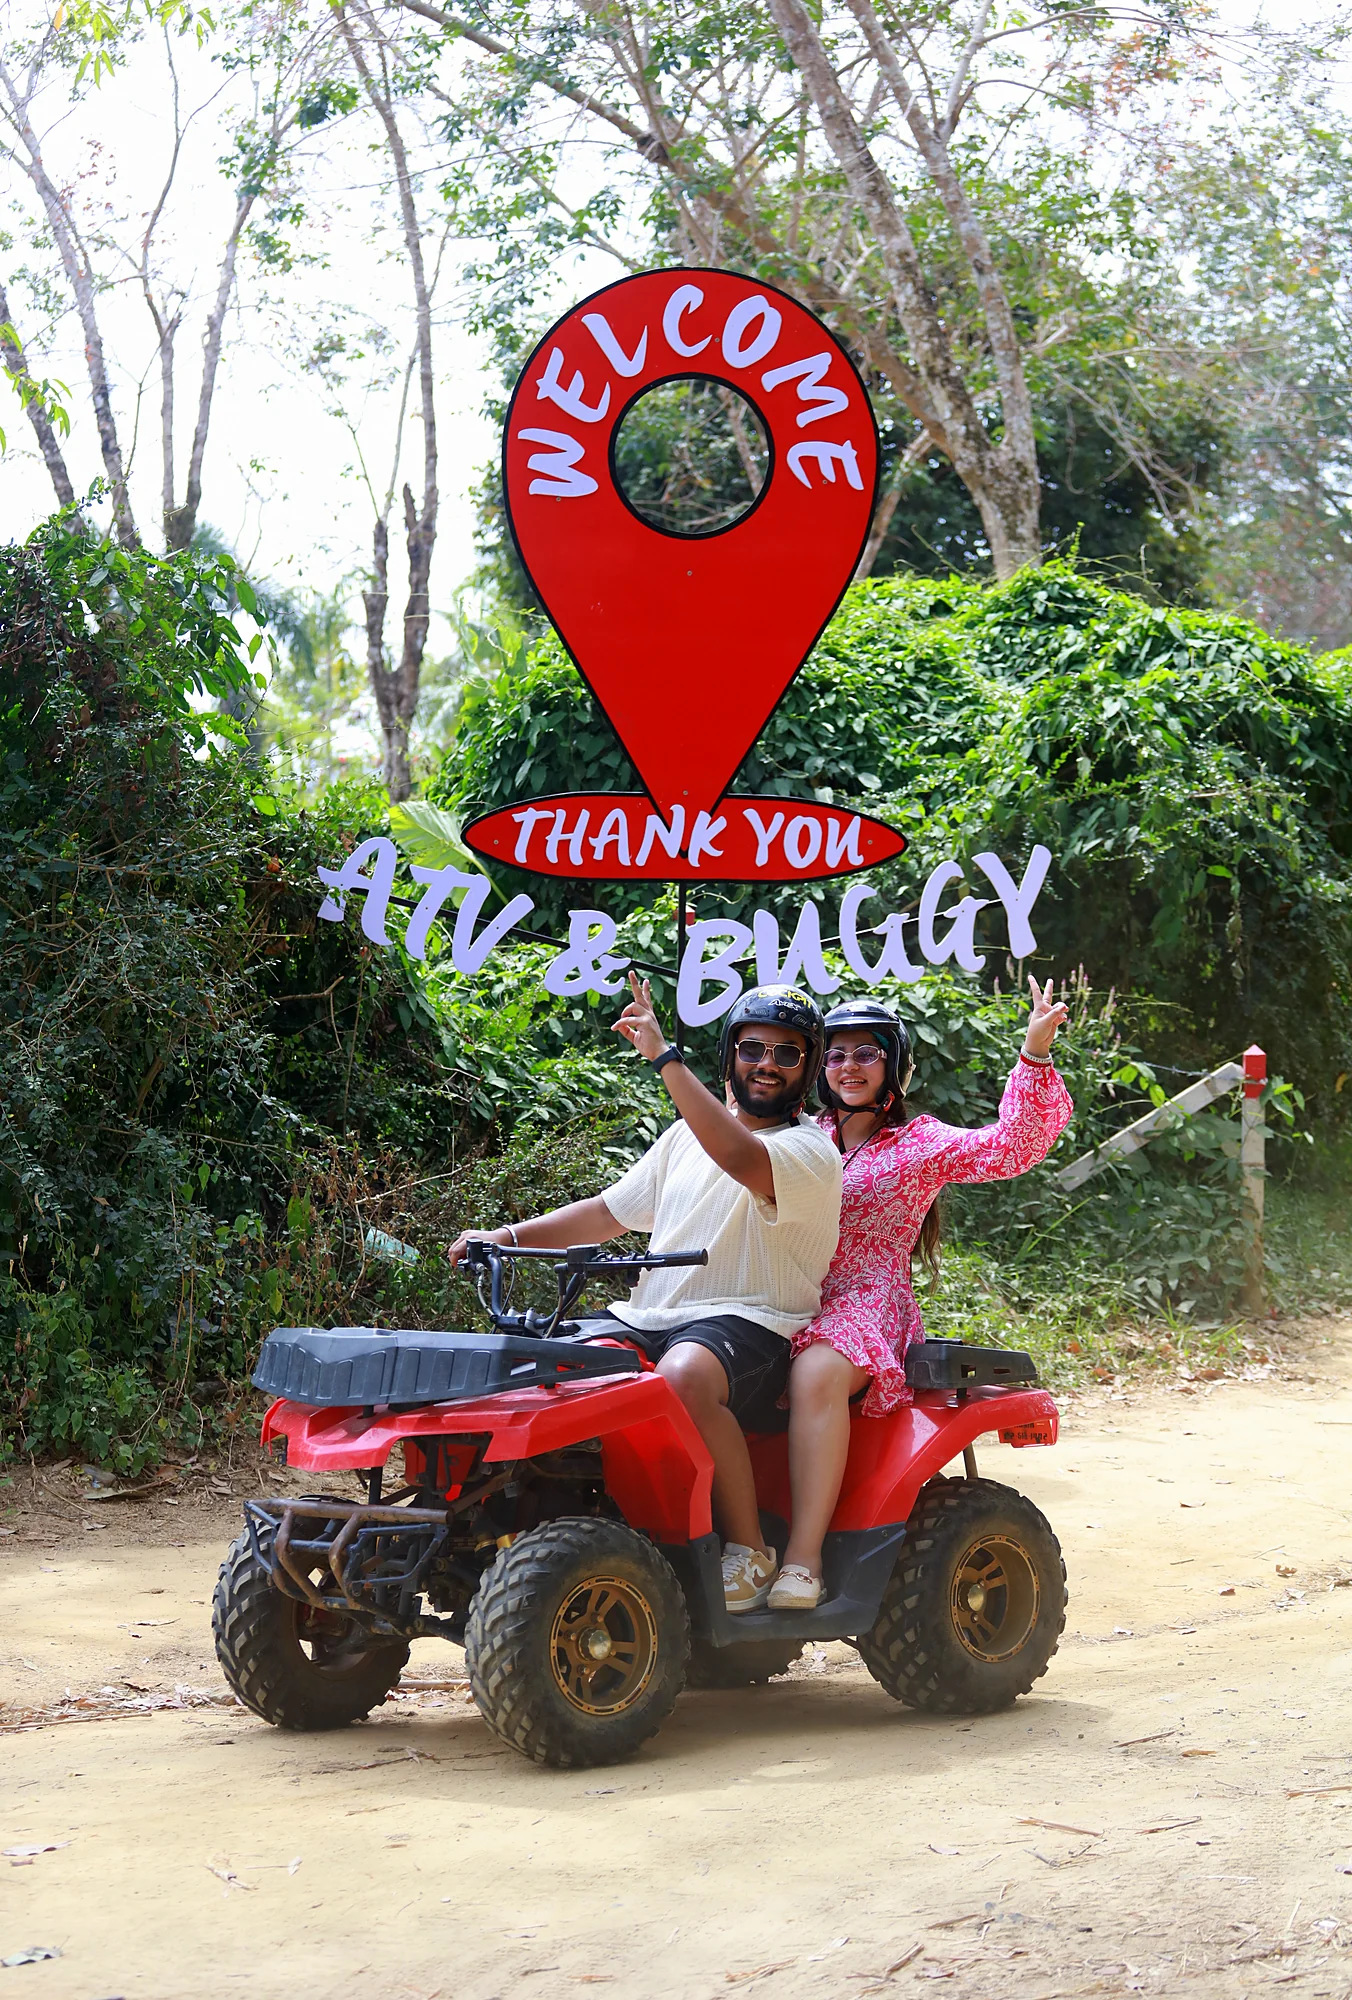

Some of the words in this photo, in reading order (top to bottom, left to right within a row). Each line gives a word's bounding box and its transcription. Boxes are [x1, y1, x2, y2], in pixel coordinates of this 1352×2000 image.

[518, 284, 864, 498] WELCOME
[512, 804, 727, 867] THANK
[742, 808, 864, 869] YOU
[317, 837, 534, 975] ATV
[544, 911, 632, 997] &
[677, 845, 1052, 1027] BUGGY
